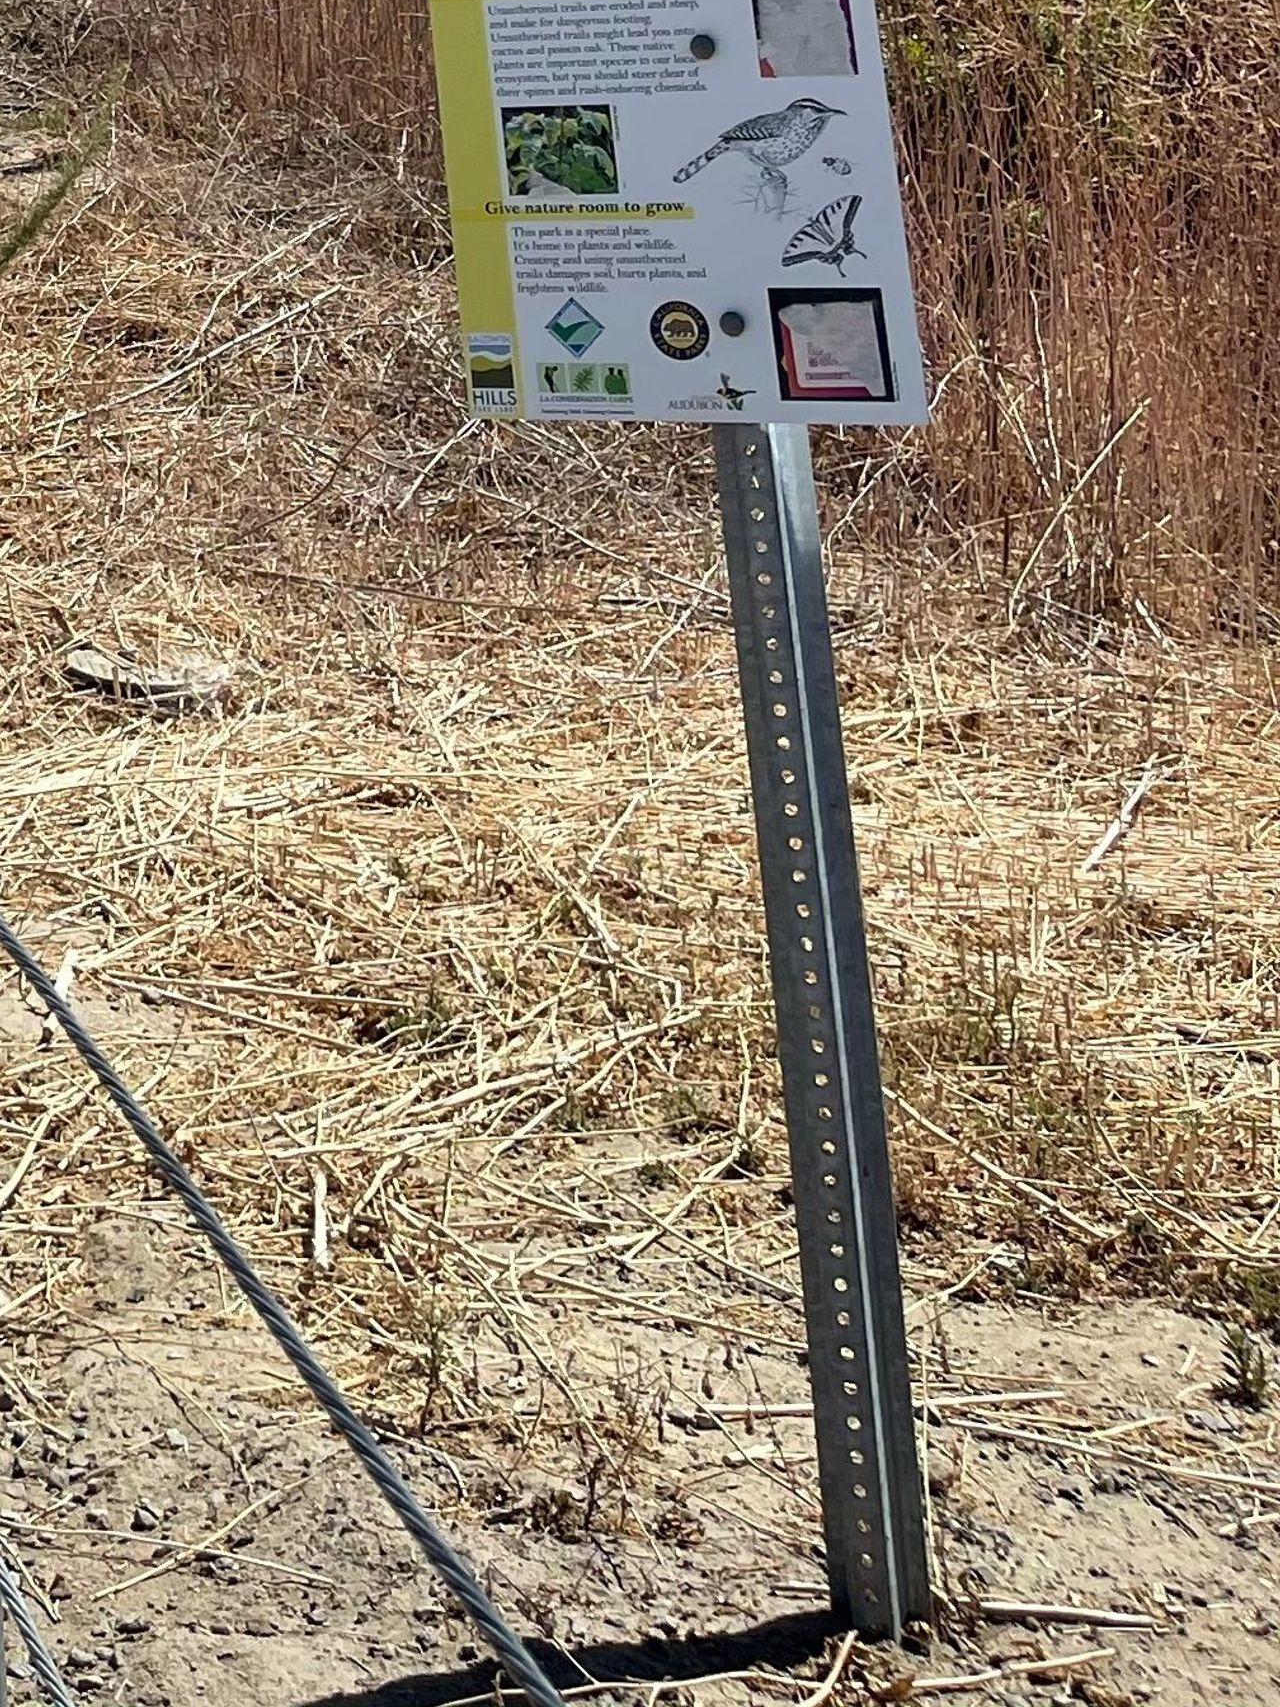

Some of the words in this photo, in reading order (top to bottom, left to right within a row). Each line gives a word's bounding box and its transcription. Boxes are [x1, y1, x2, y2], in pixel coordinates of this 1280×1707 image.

[488, 3, 558, 16] Unauthorized
[560, 2, 588, 12] trails
[590, 3, 606, 12] are
[608, 0, 644, 11] eroded
[647, 0, 667, 9] and
[489, 19, 507, 29] and
[511, 18, 537, 28] make
[540, 17, 554, 27] for
[557, 16, 611, 29] dangerous
[490, 31, 561, 43] Unauthorized
[564, 29, 591, 39] trails
[593, 29, 625, 40] might
[628, 27, 649, 37] lead
[651, 30, 671, 40] you
[492, 48, 524, 56] cactus
[526, 45, 545, 54] and
[547, 46, 582, 57] poison
[608, 42, 641, 52] These
[643, 42, 675, 51] native
[494, 60, 524, 73] plants
[527, 61, 543, 69] are
[546, 59, 597, 70] important
[600, 58, 637, 68] species
[639, 57, 650, 65] in
[652, 57, 672, 65] our
[674, 54, 697, 64] loca
[552, 71, 570, 81] but
[571, 73, 592, 82] you
[594, 70, 629, 80] should
[631, 70, 657, 79] steer
[660, 68, 686, 78] clear
[688, 67, 700, 77] of
[485, 200, 520, 214] Give
[525, 203, 574, 213] nature
[579, 202, 620, 213] room
[624, 202, 641, 213] to
[646, 202, 686, 218] grow
[511, 227, 536, 237] This
[538, 227, 562, 239] park
[565, 229, 574, 237] is
[576, 229, 582, 237] a
[585, 226, 620, 239] special
[532, 241, 561, 251] home
[564, 242, 575, 251] to
[578, 240, 609, 253] plants
[612, 240, 632, 250] and
[514, 255, 560, 268] Creating
[563, 254, 582, 264] and
[584, 257, 614, 268] using
[616, 253, 687, 264] unauthorized
[516, 269, 543, 279] trails
[545, 269, 590, 281] damages
[617, 268, 646, 279] hurts
[687, 267, 707, 278] and
[652, 303, 705, 327] CALIFORNIA
[473, 390, 517, 406] HILLS
[667, 399, 723, 410] AUDUBON
